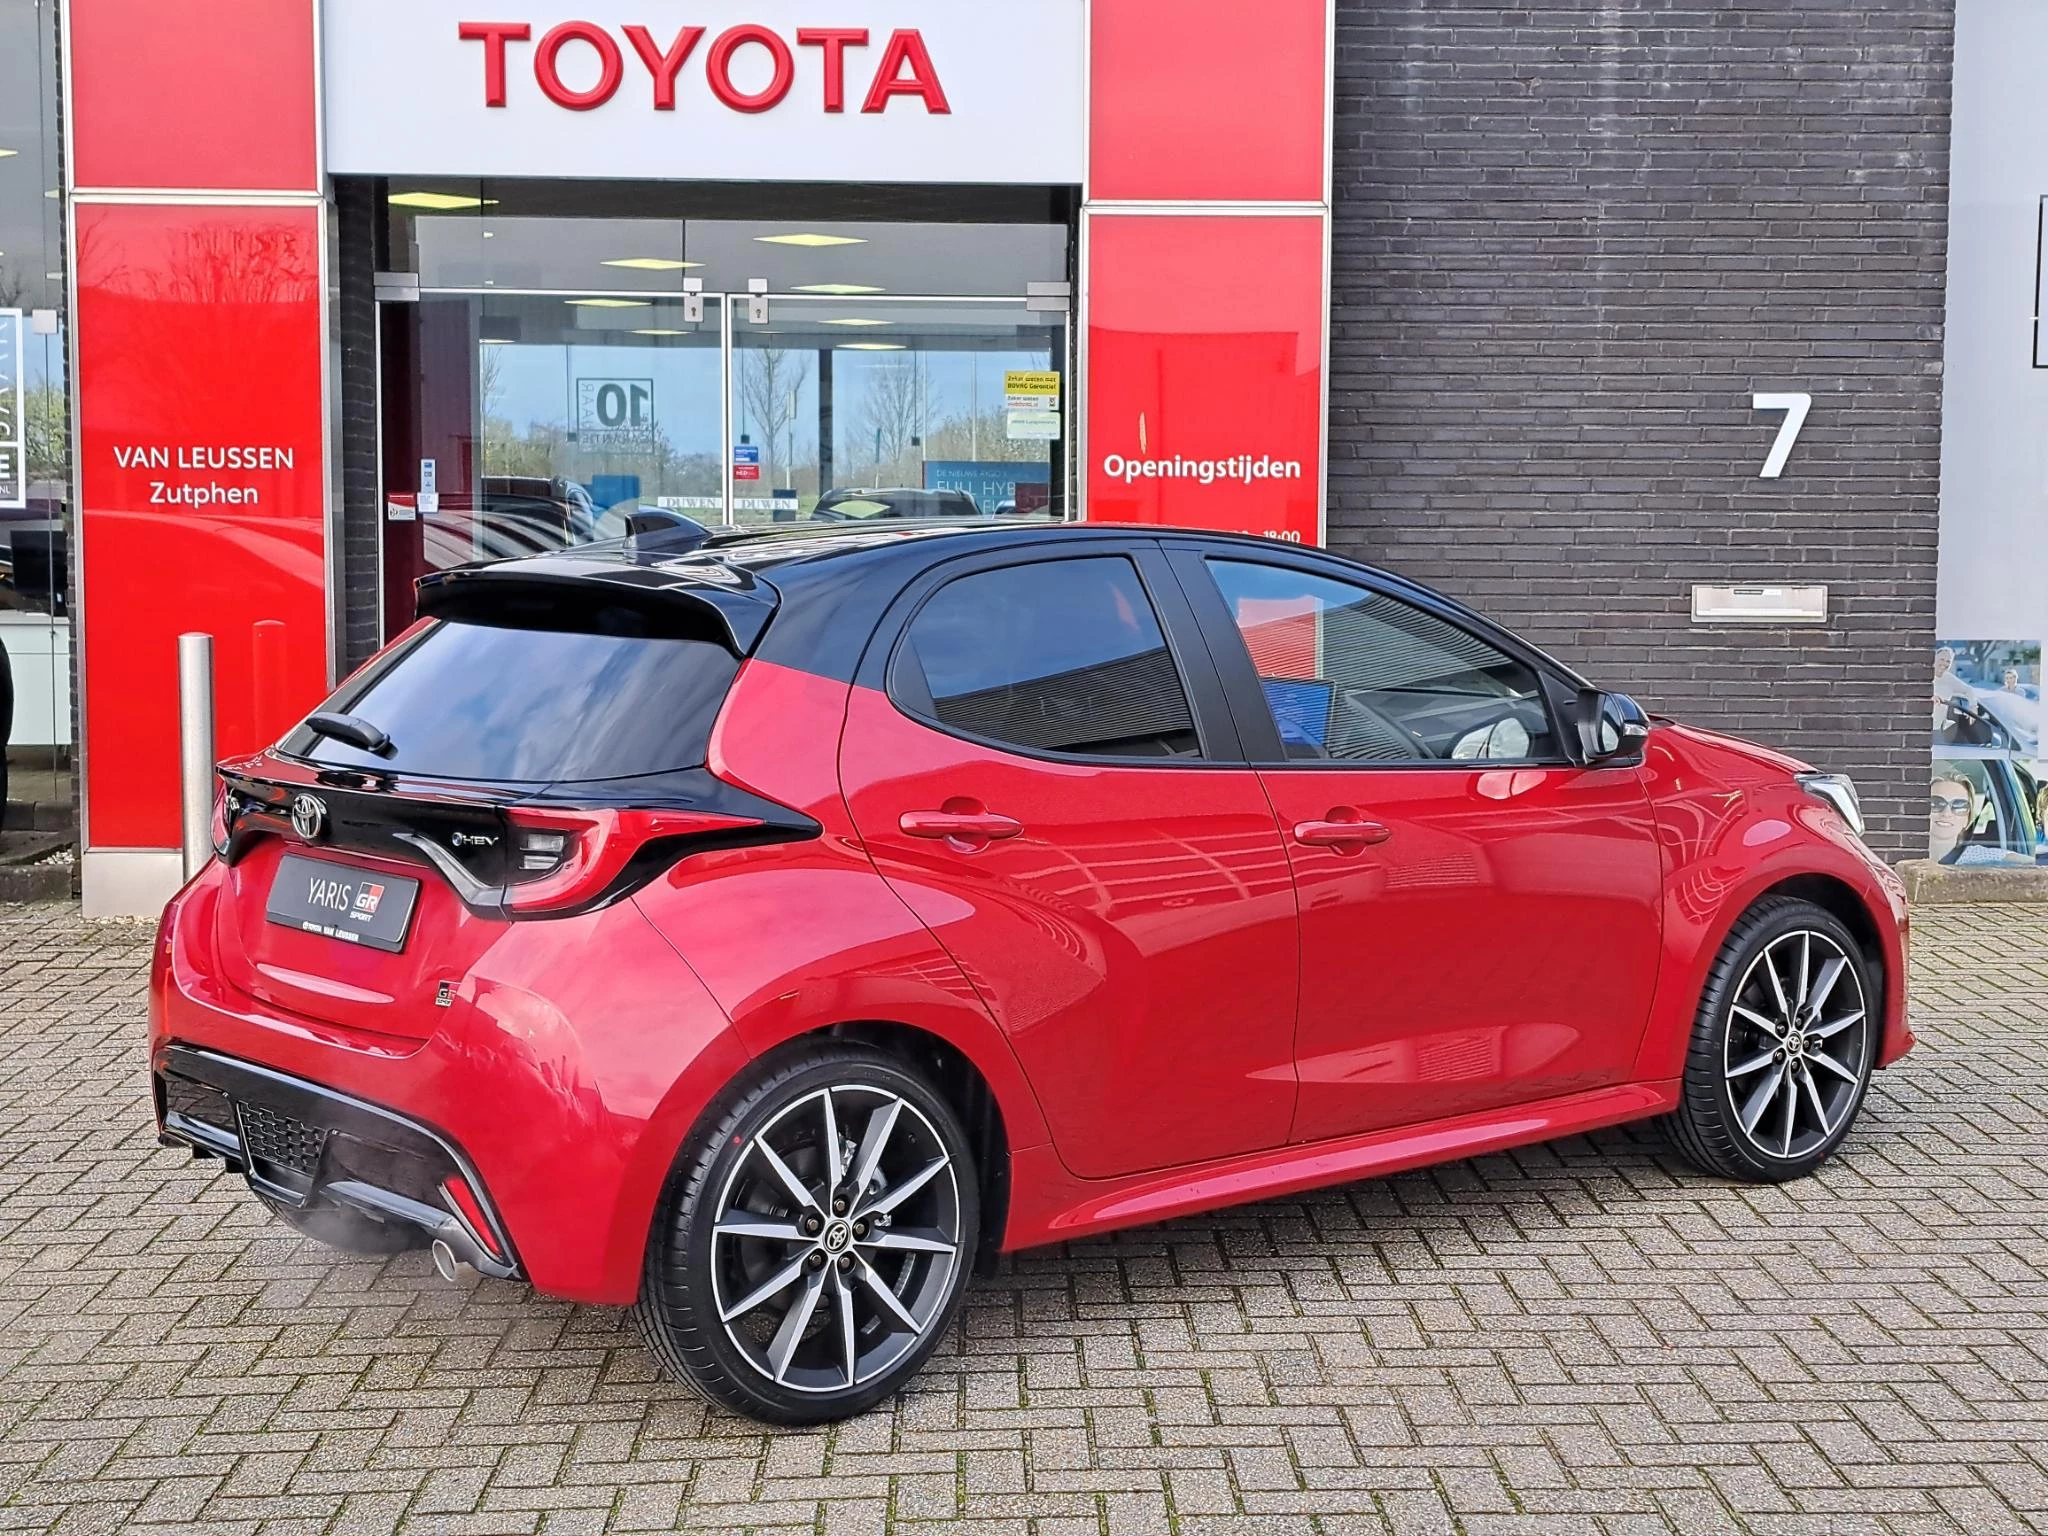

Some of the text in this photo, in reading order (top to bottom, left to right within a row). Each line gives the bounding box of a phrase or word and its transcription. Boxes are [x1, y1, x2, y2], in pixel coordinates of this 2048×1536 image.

[458, 20, 952, 113] TOYOTA
[1753, 393, 1812, 478] 7
[113, 446, 293, 470] VAN LEUSSEN
[1103, 454, 1301, 484] Openingstijden
[149, 481, 258, 509] Zutphen
[983, 481, 1016, 496] HYB
[666, 498, 717, 507] DUWEN
[742, 499, 791, 509] DUWEN
[462, 834, 499, 846] HEV
[308, 877, 352, 911] YARIS
[355, 893, 378, 910] GR
[349, 911, 374, 923] SPORT
